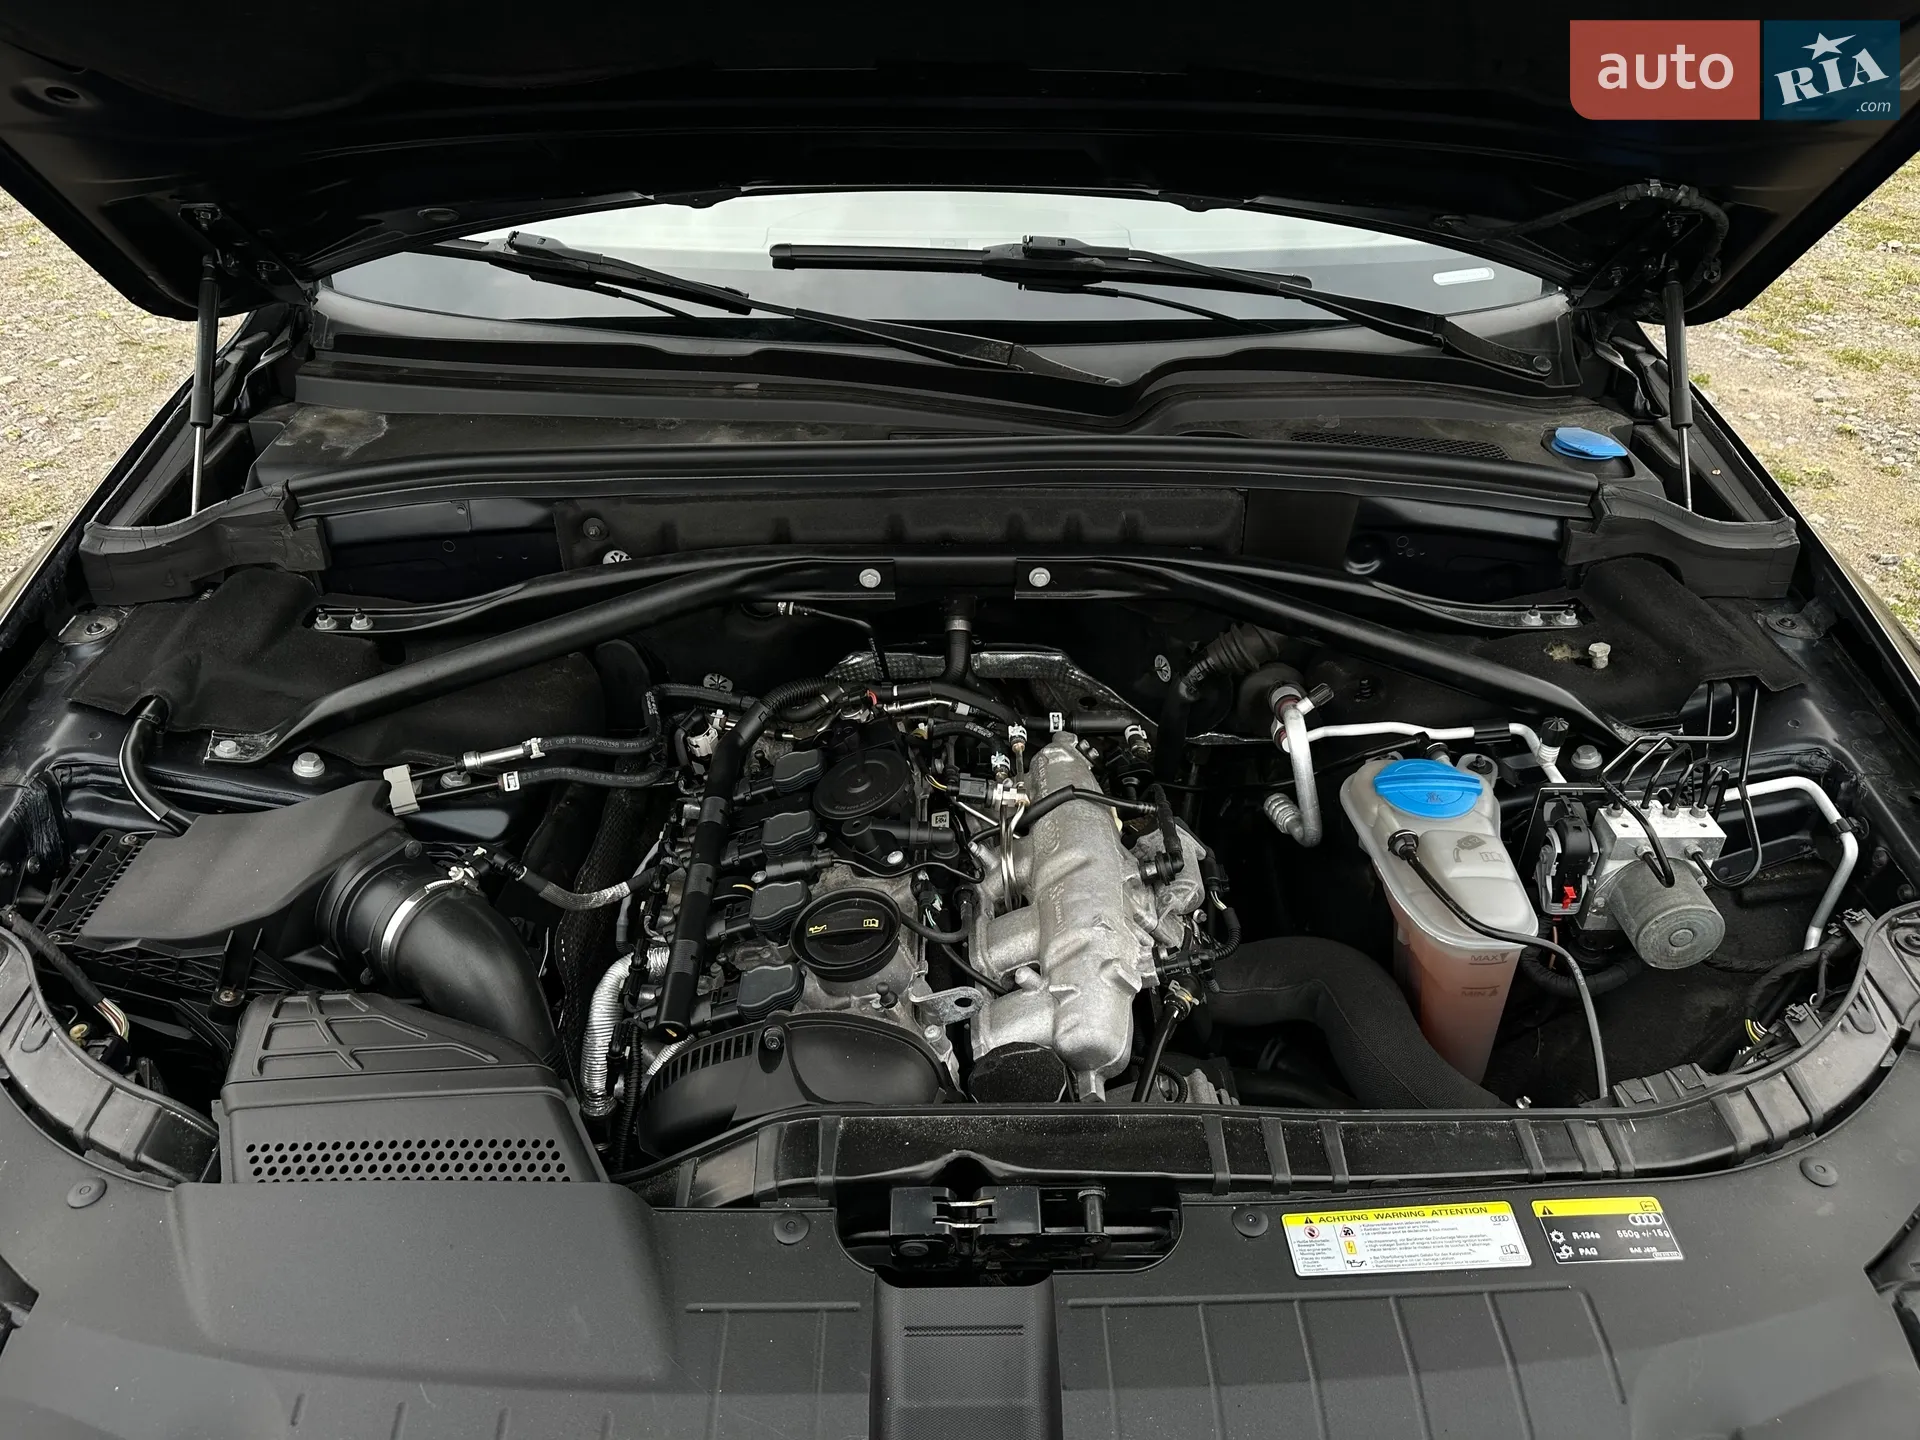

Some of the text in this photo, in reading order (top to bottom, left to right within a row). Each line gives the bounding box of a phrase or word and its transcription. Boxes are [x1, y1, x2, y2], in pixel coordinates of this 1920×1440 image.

[1318, 1207, 1488, 1223] ACHTUNG WARNING ATTENTION
